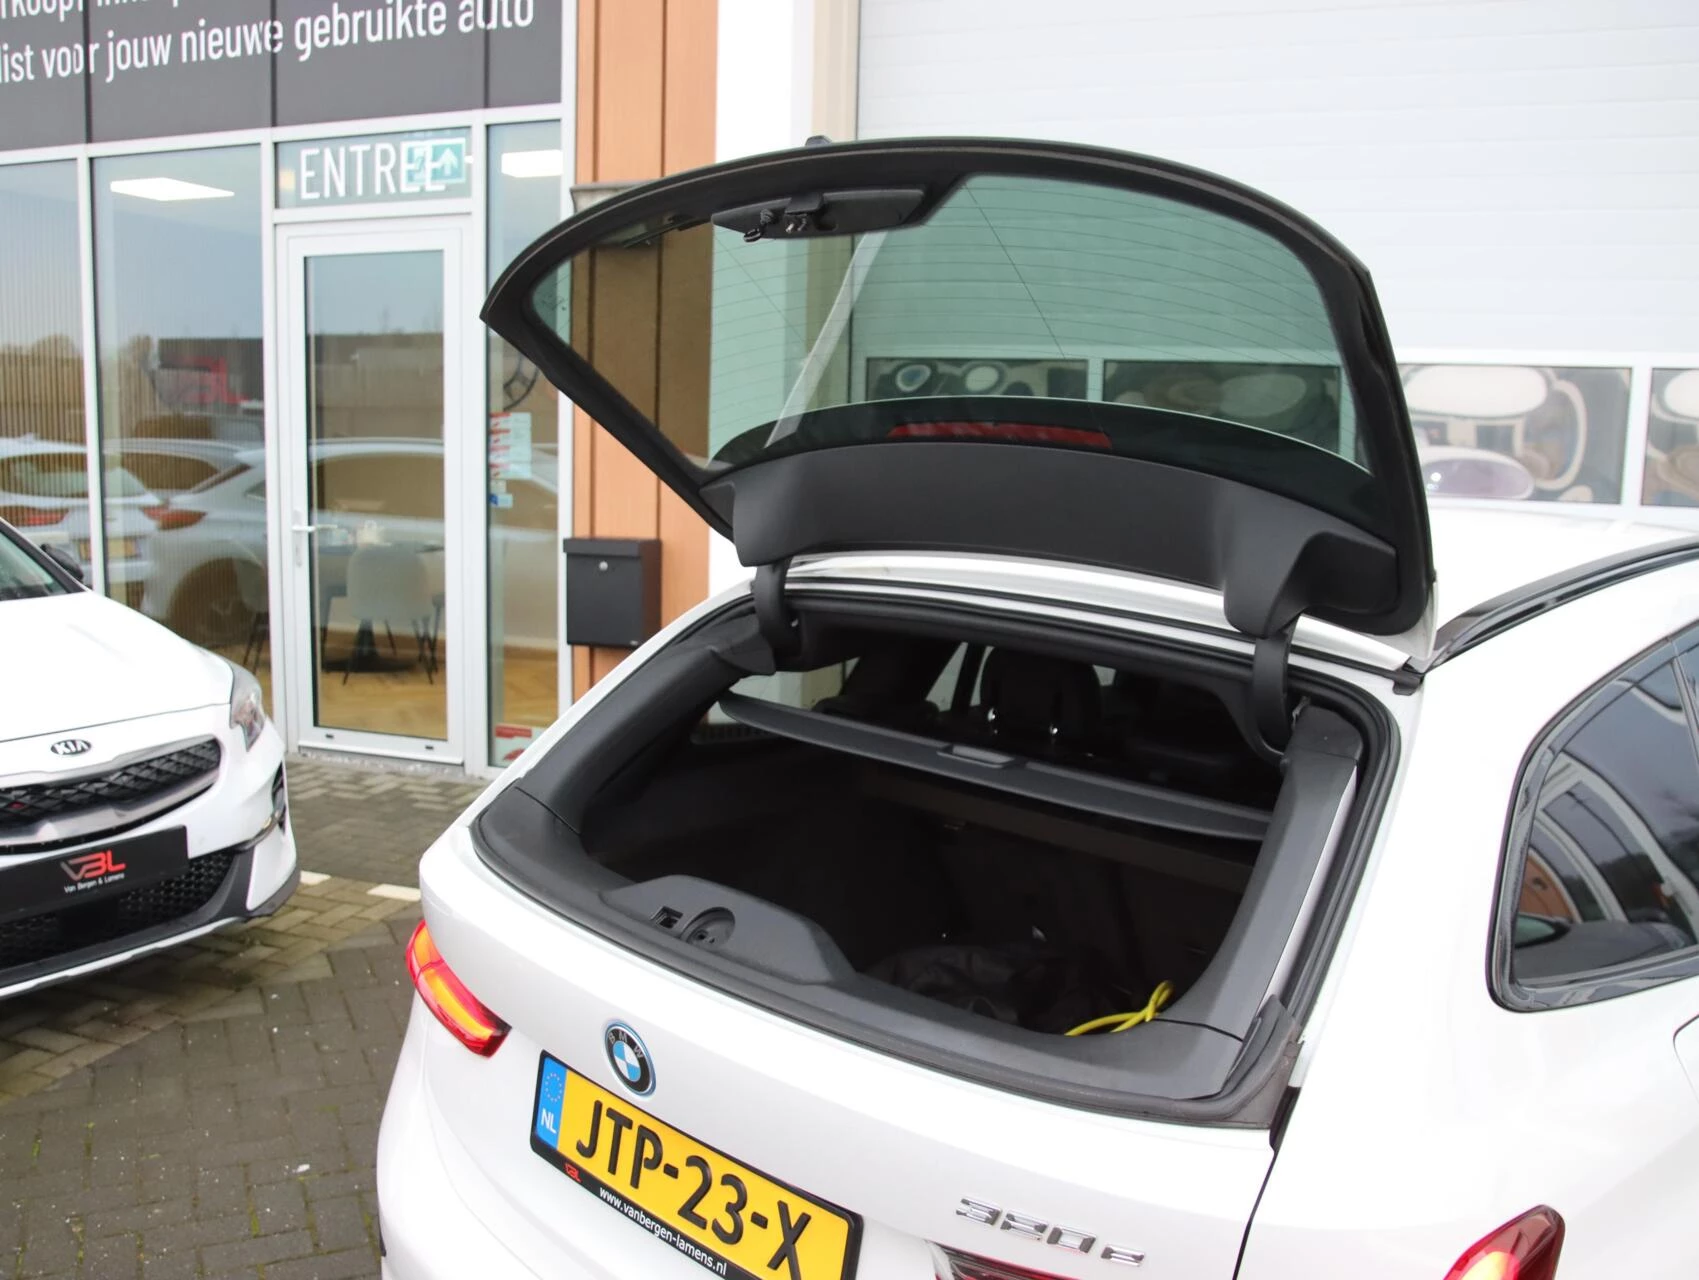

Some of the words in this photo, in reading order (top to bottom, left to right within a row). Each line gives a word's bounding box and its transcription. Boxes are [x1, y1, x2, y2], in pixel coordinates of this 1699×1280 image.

[41, 43, 100, 78] voor
[105, 29, 172, 83] jouw
[181, 18, 283, 63] nieuwe
[294, 0, 447, 62] gebruikte
[458, 0, 534, 33] auto
[301, 138, 447, 200] ENTREE
[53, 740, 90, 755] KIA
[608, 1030, 645, 1060] BMW
[541, 1107, 557, 1134] NL
[576, 1099, 812, 1280] JTP-23-X
[600, 1186, 728, 1275] www.vanbergen-lamens.nl
